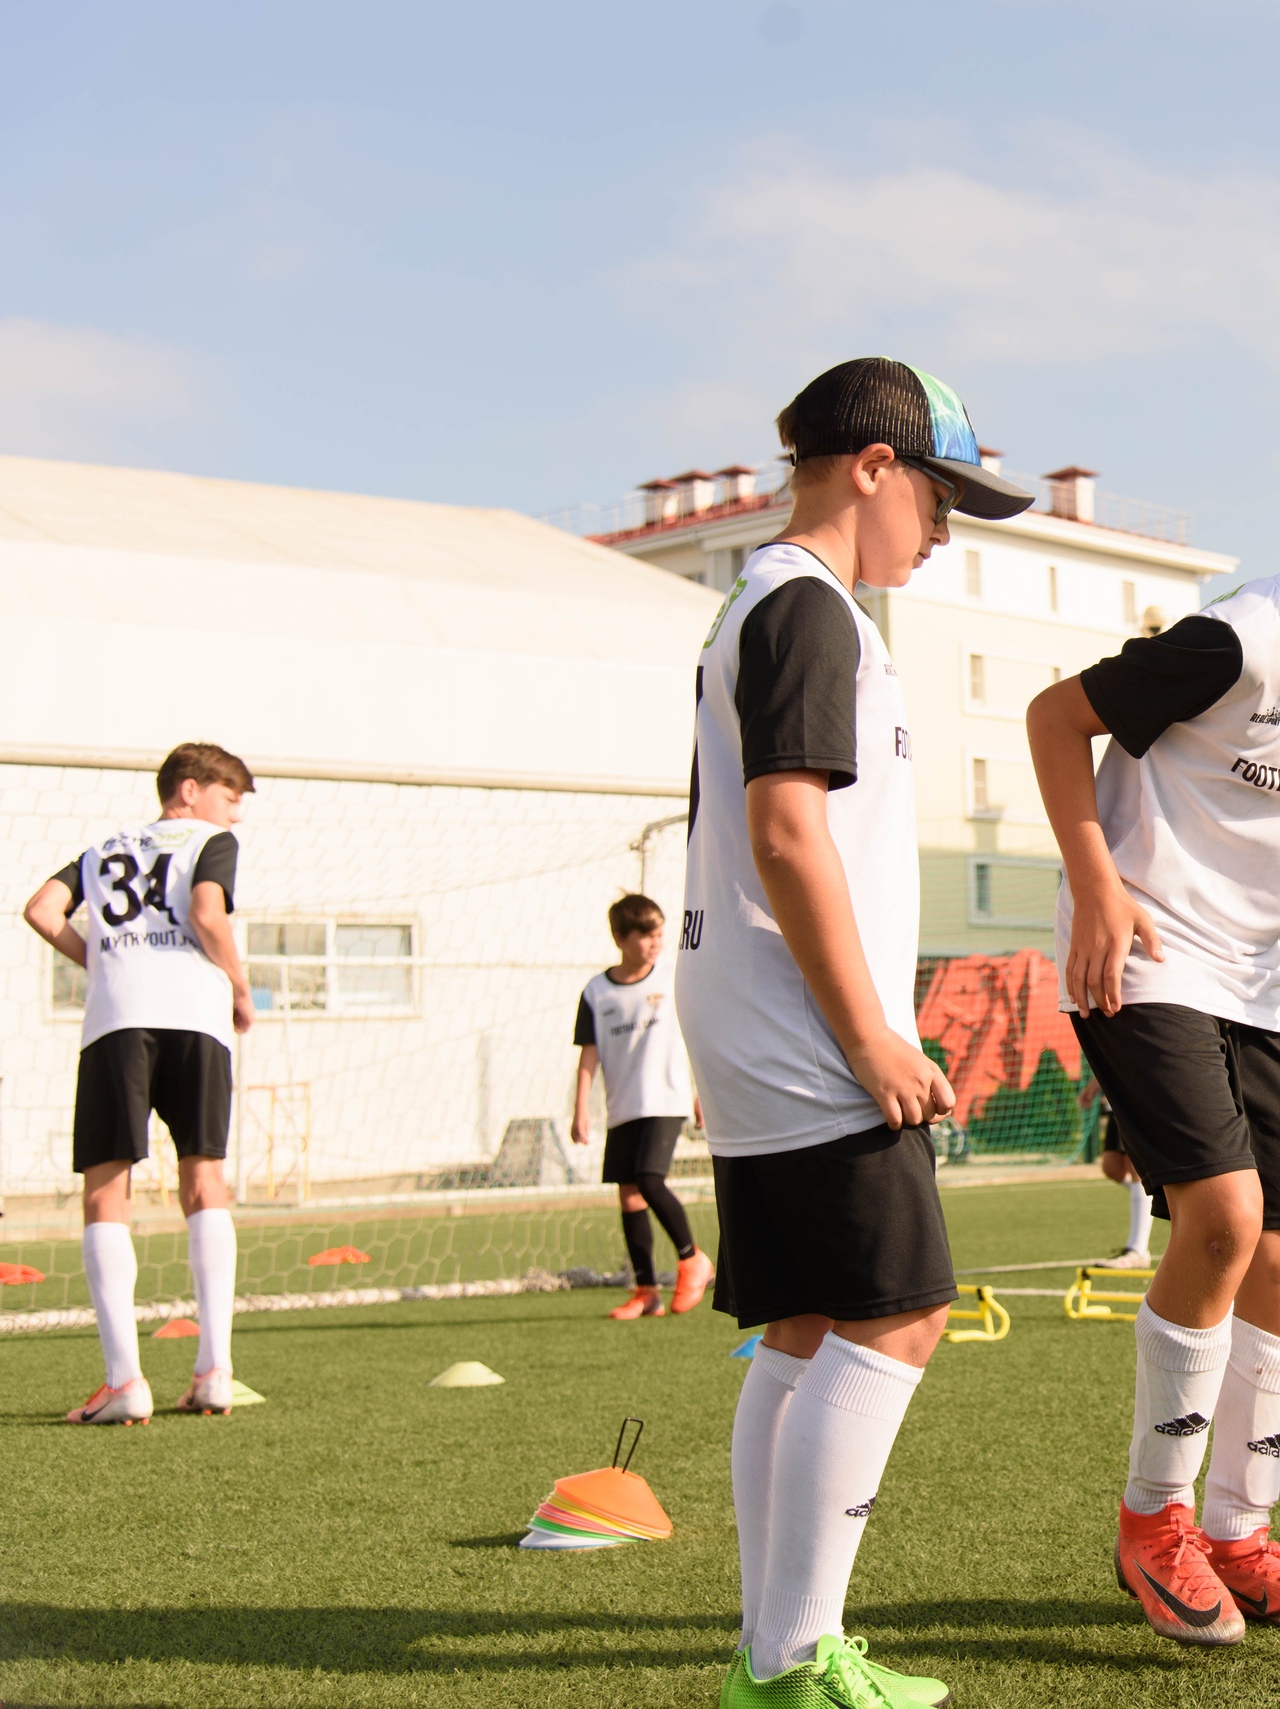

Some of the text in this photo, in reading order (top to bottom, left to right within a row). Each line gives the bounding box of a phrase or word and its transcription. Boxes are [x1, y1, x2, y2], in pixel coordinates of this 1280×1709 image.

[99, 854, 180, 927] 34
[1154, 1419, 1211, 1437] adidas
[845, 1508, 872, 1517] ad
